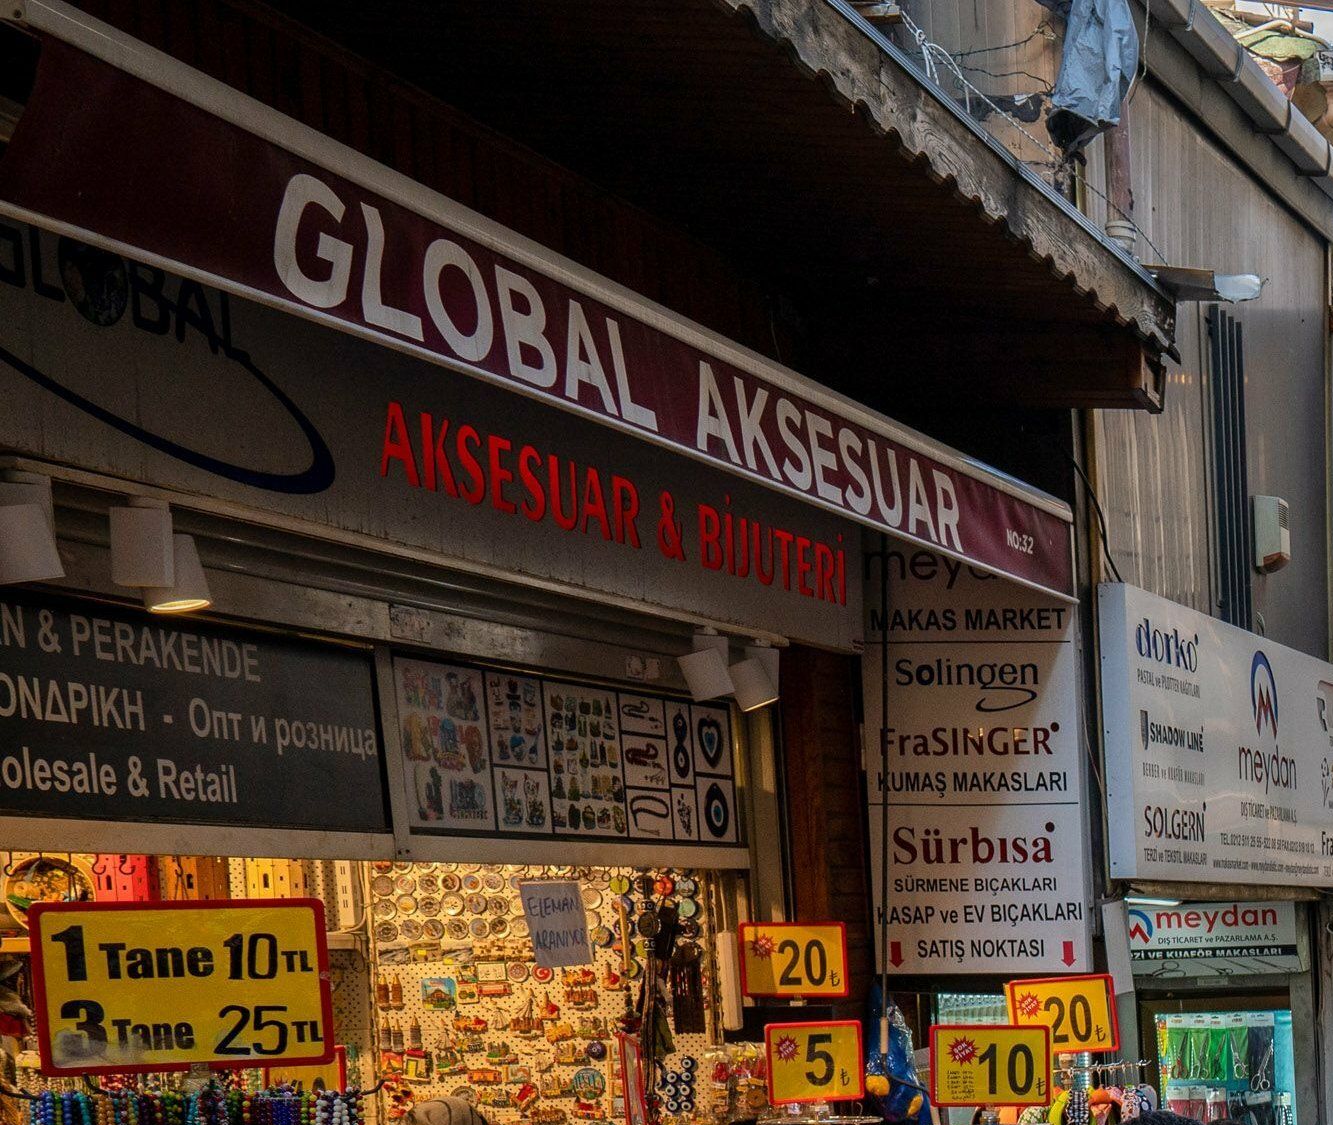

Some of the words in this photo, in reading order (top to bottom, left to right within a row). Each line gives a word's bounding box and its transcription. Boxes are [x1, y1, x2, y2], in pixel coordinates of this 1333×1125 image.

[274, 173, 659, 433] GLOBAL
[696, 360, 964, 553] AKSESUAR
[381, 401, 642, 549] AKSESUAR
[657, 490, 687, 563] &
[698, 494, 848, 606] BİJUTERİ
[1006, 528, 1034, 555] NO:32
[869, 608, 957, 632] MAKAS
[964, 607, 1066, 632] MARKET
[37, 607, 62, 655] &
[71, 617, 262, 683] PERAKENDE
[1135, 617, 1198, 673] dorko
[895, 658, 1040, 711] Solingen
[189, 697, 243, 742] Опт
[252, 711, 267, 743] и
[275, 715, 378, 761] розница
[880, 727, 1054, 756] FraSINGER
[1149, 720, 1186, 748] SHADOW
[1186, 731, 1204, 753] LINE
[1, 747, 117, 799] olesale
[127, 756, 150, 797] &
[156, 758, 239, 804] Retail
[877, 772, 947, 797] KUMAŞ
[952, 771, 1068, 792] MAKASLARI
[1238, 745, 1297, 795] meydan
[1144, 805, 1206, 843] SOLGERN
[894, 875, 970, 893] SÜRMENE
[974, 877, 1057, 896] BIÇAKLARI
[526, 896, 581, 918] ELEMAN
[877, 905, 935, 925] KASAP
[939, 909, 959, 923] ve
[963, 904, 985, 923] EV
[991, 902, 1083, 927] BIÇAKLARI
[1155, 904, 1278, 933] meydan
[51, 924, 89, 983] 1
[99, 942, 215, 981] Tane
[917, 939, 965, 963] SATIŞ
[970, 939, 1045, 958] NOKTASI
[1171, 936, 1203, 945] TİCARET
[1215, 934, 1262, 943] PAZARLAMA
[60, 1000, 108, 1055] 3
[112, 1017, 195, 1052] Tane
